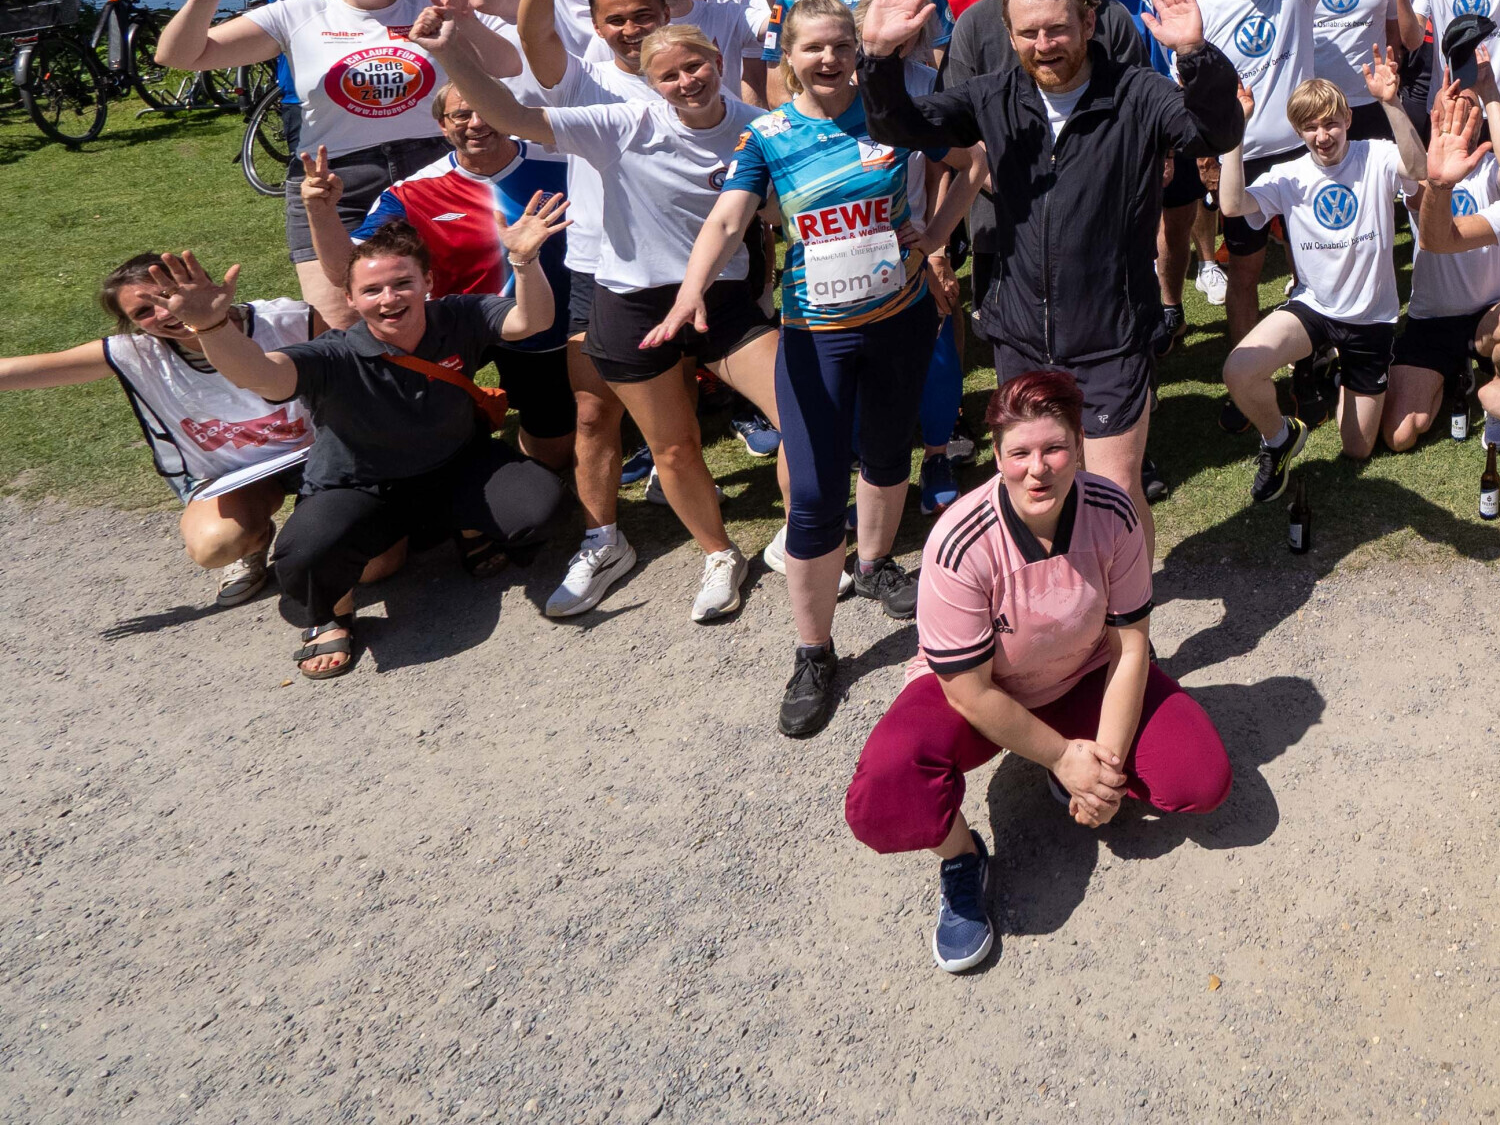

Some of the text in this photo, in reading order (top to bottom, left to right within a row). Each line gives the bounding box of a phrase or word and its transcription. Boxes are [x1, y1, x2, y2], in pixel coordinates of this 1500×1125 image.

[342, 54, 360, 66] ICH
[364, 61, 404, 73] Jede
[352, 71, 404, 87] Oma
[361, 85, 409, 101] zählt
[797, 198, 889, 241] REWE
[1301, 242, 1313, 251] VW
[814, 274, 872, 299] apm
